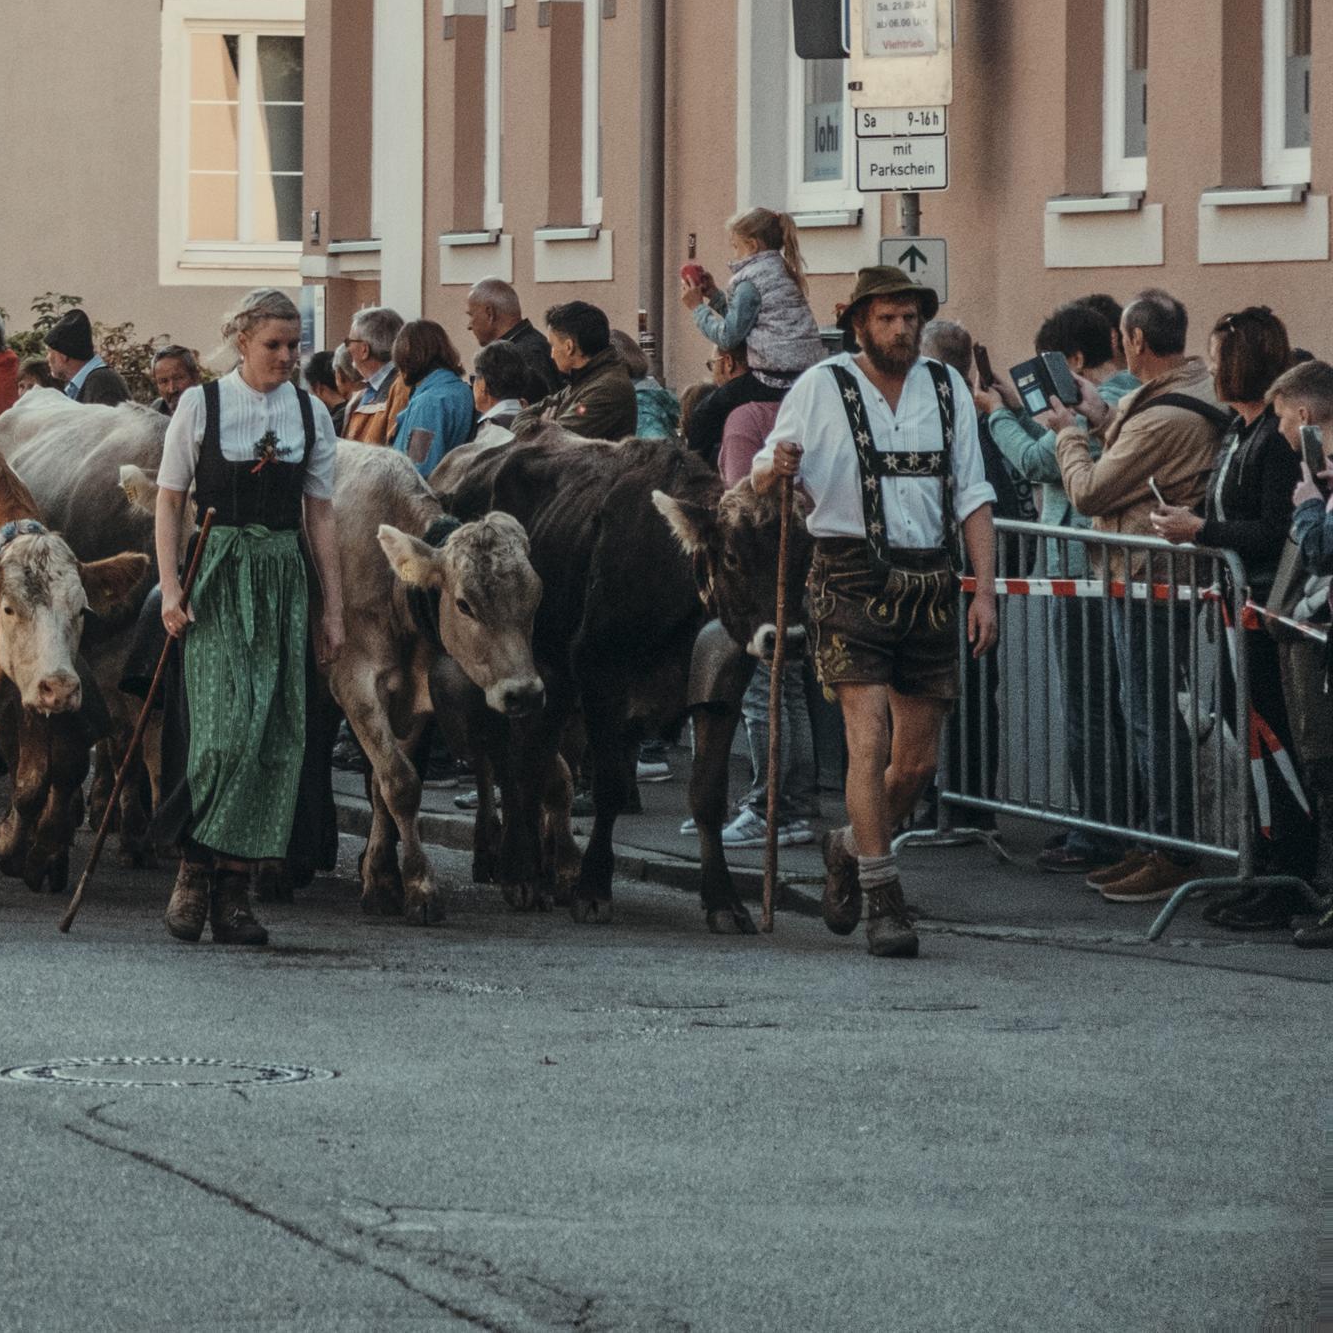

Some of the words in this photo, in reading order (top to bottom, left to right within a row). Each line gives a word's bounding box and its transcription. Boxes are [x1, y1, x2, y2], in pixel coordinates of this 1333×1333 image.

[863, 113, 878, 128] Sa
[932, 111, 940, 126] h
[814, 108, 840, 154] lohi
[892, 142, 913, 156] mit
[869, 162, 936, 177] Parkschein
